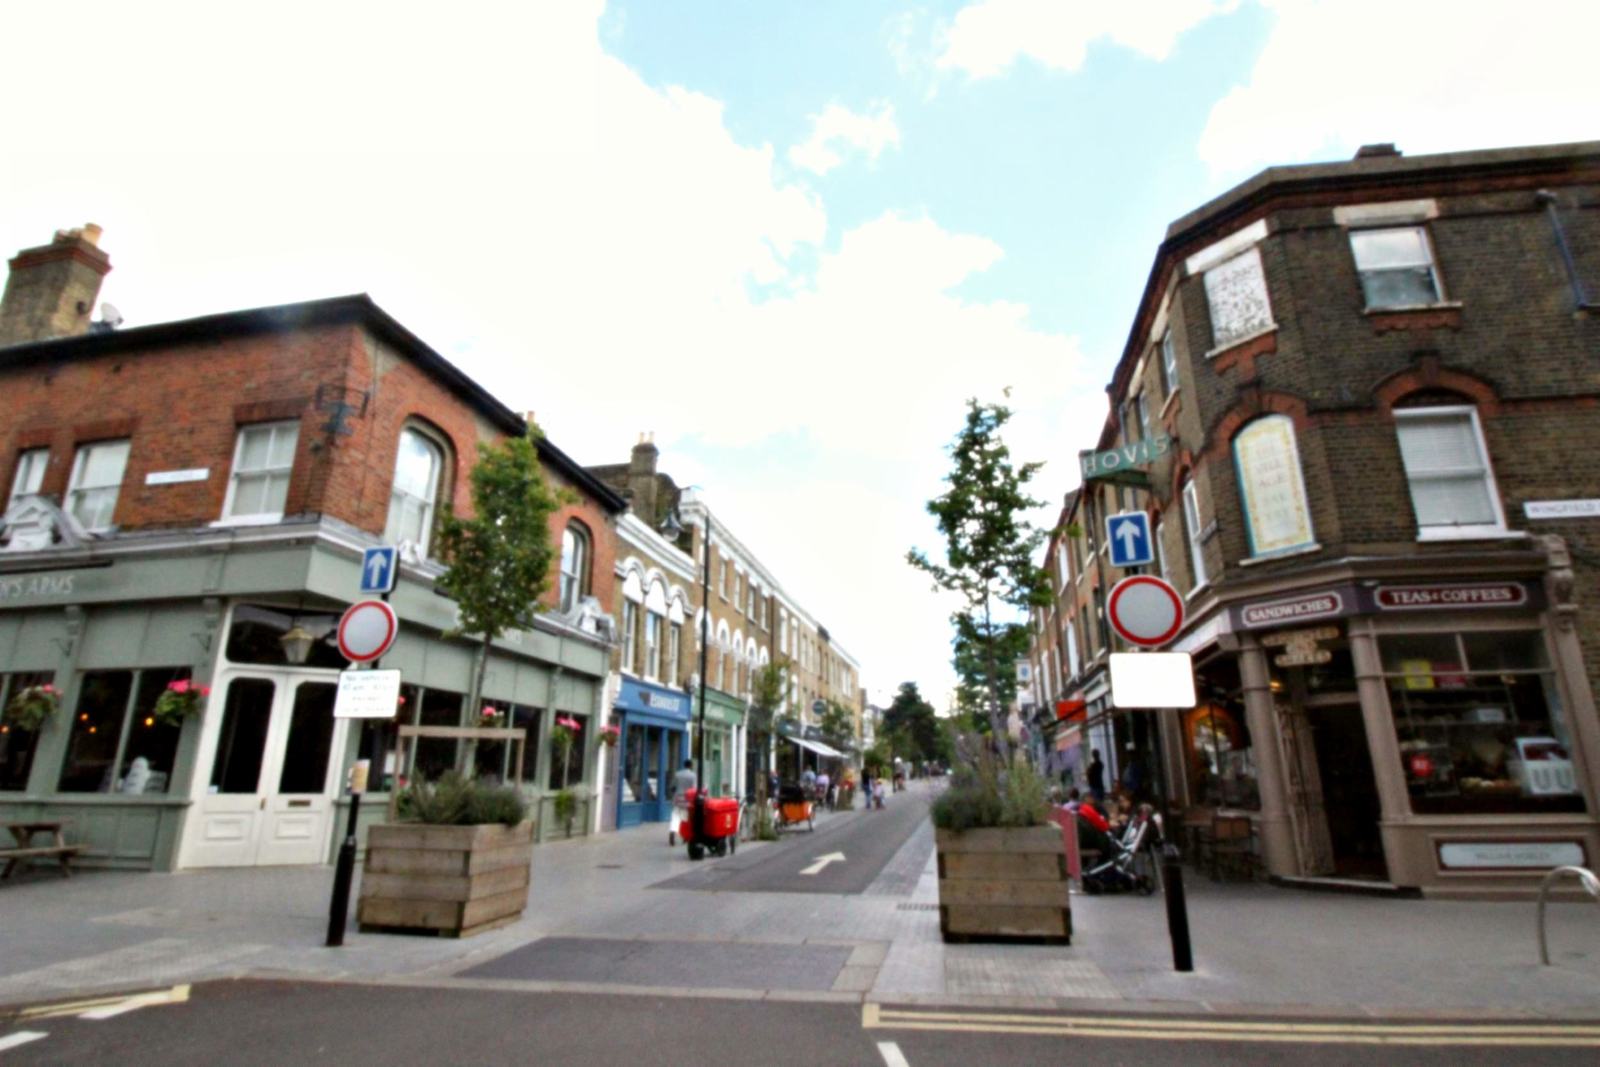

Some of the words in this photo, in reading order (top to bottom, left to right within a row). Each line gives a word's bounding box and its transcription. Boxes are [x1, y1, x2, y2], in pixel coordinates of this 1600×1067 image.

[1082, 435, 1168, 473] HOVIS
[25, 575, 75, 595] ARMS
[1391, 591, 1431, 604] TEAS
[1440, 588, 1512, 602] COFFEES
[1249, 598, 1333, 621] SANDWICHES
